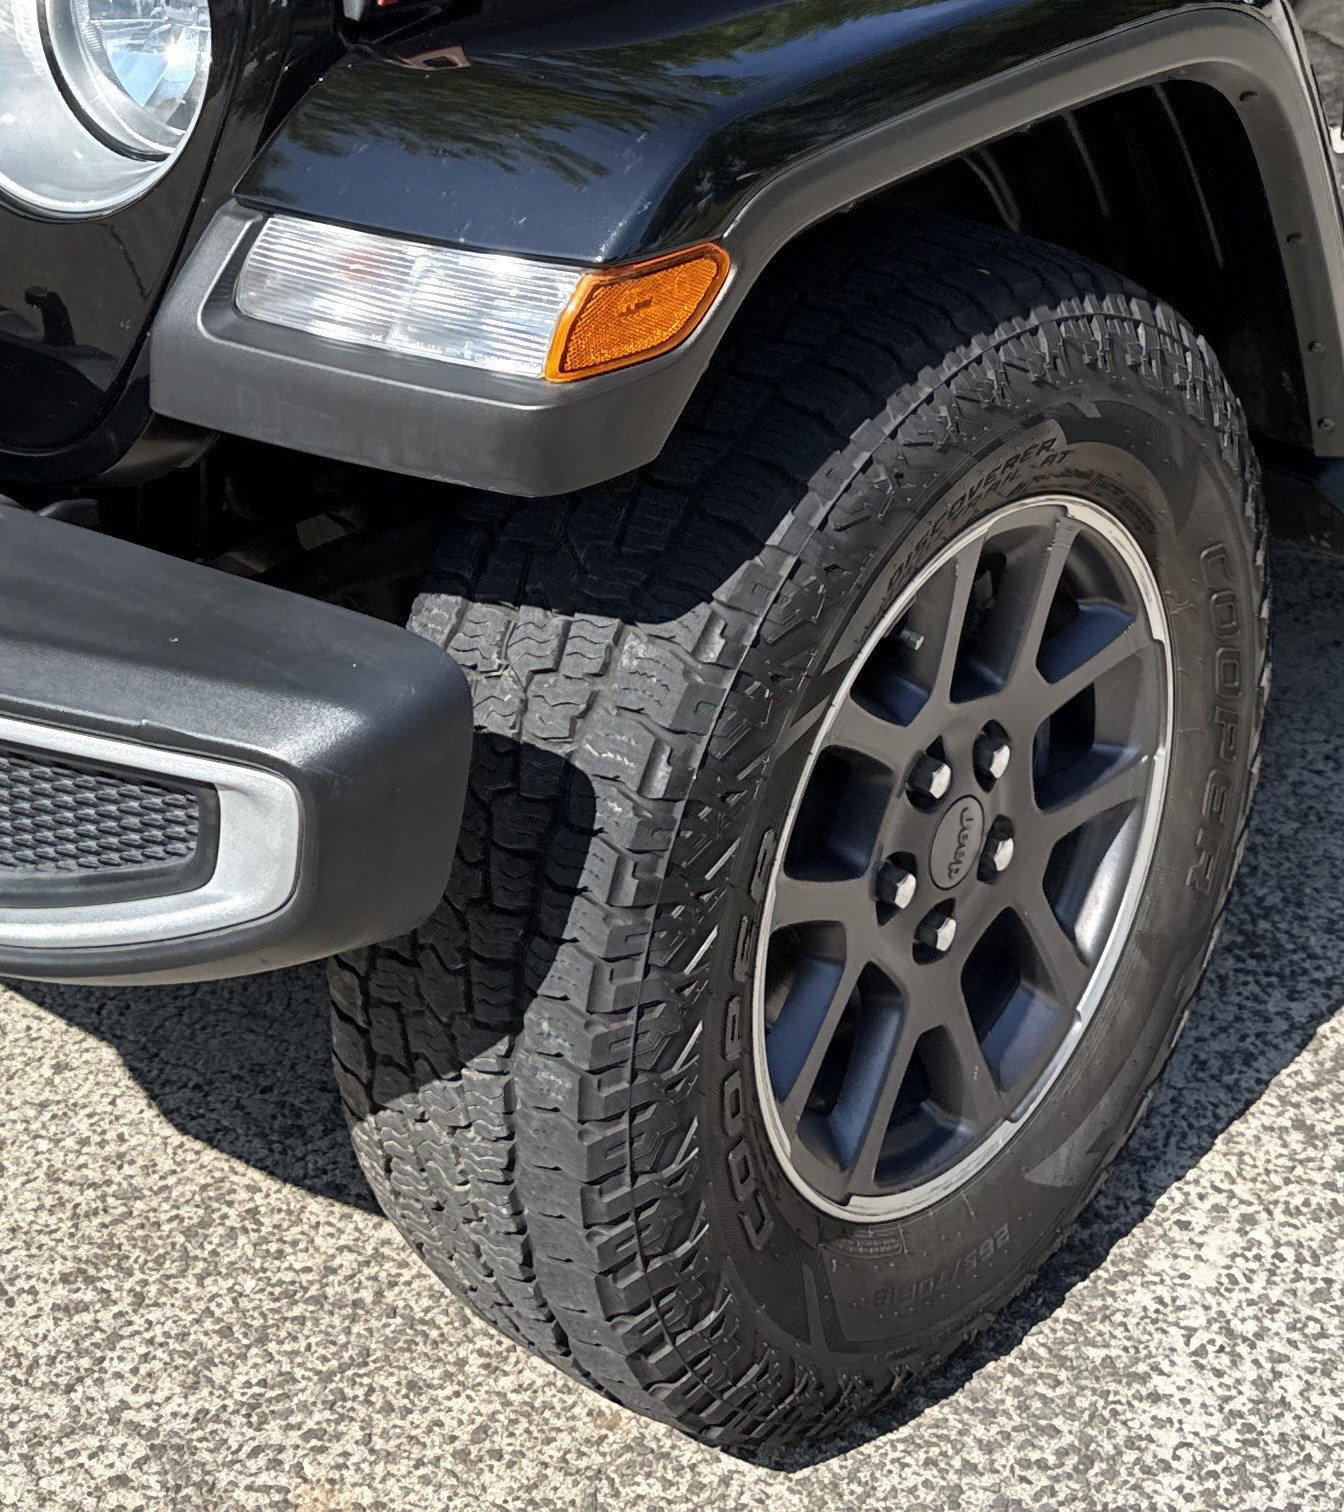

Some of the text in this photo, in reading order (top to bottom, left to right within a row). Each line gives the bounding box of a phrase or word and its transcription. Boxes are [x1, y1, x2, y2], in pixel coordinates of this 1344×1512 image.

[948, 806, 975, 880] Jeep
[1186, 543, 1244, 893] COOPER
[723, 826, 775, 1251] COOPER
